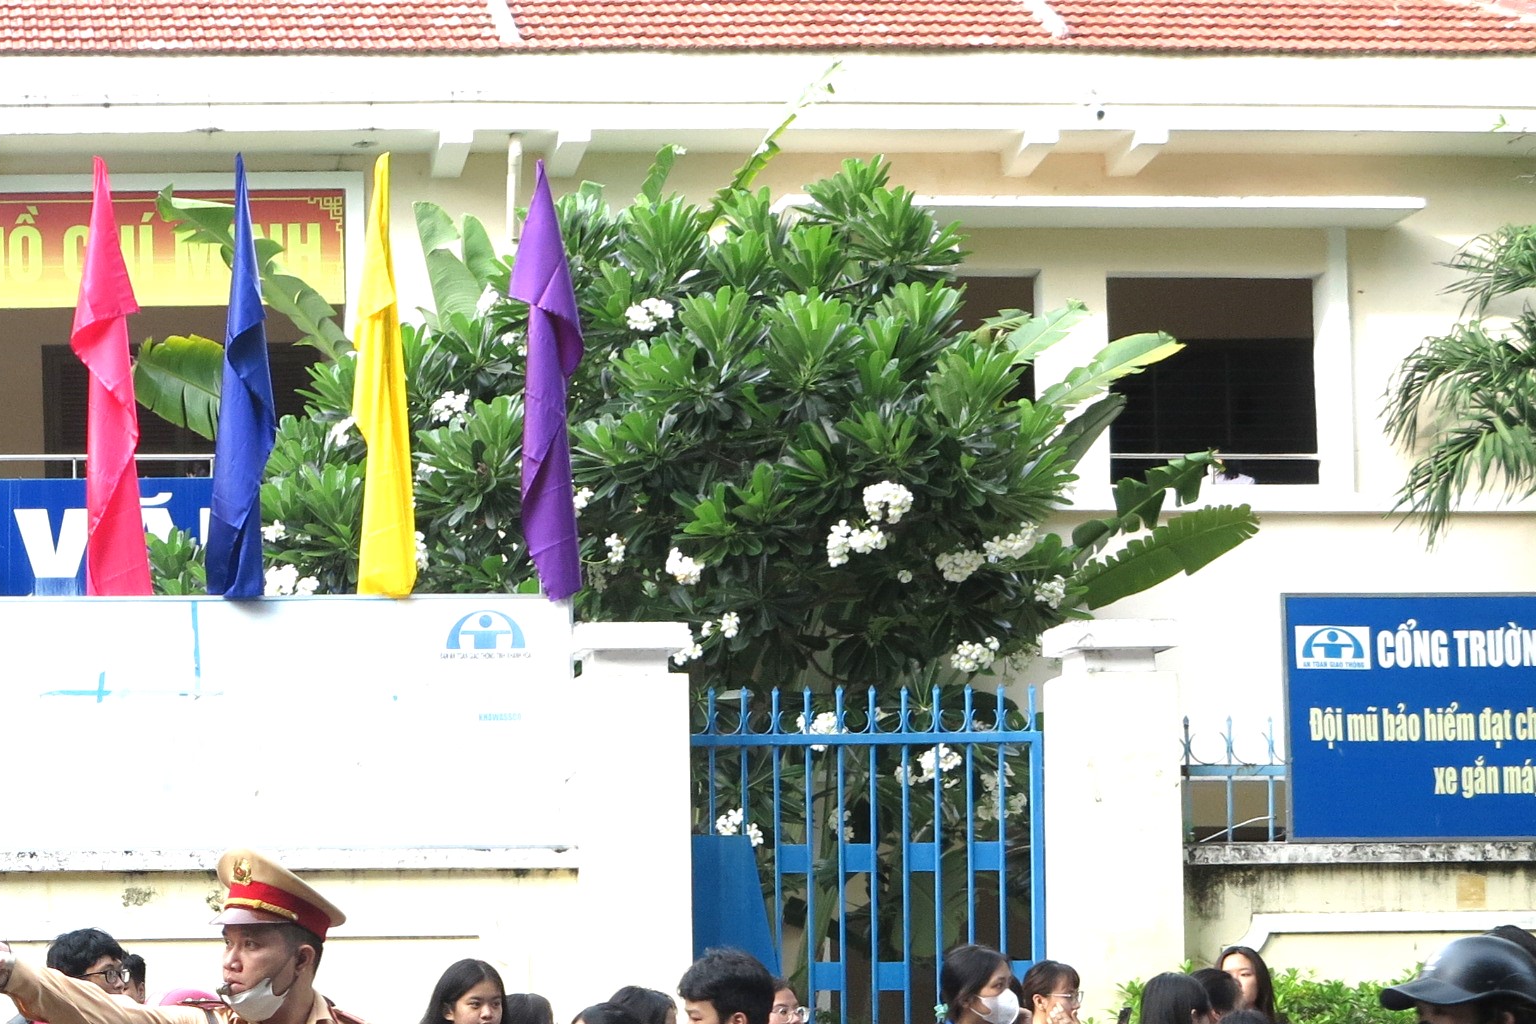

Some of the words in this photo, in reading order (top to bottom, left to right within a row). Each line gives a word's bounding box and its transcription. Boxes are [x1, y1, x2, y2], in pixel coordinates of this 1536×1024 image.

[175, 222, 322, 283] MNH
[1376, 618, 1448, 669] CỔNG
[1452, 621, 1536, 668] TRƯỜN
[1309, 706, 1343, 749] Đội
[1347, 706, 1379, 742] mũ
[1382, 702, 1420, 742] bảo
[1424, 701, 1476, 742] hiểm
[1478, 706, 1512, 749] đạt
[1515, 706, 1536, 741] ch
[1433, 766, 1458, 795] xe
[1461, 755, 1499, 799] gắn
